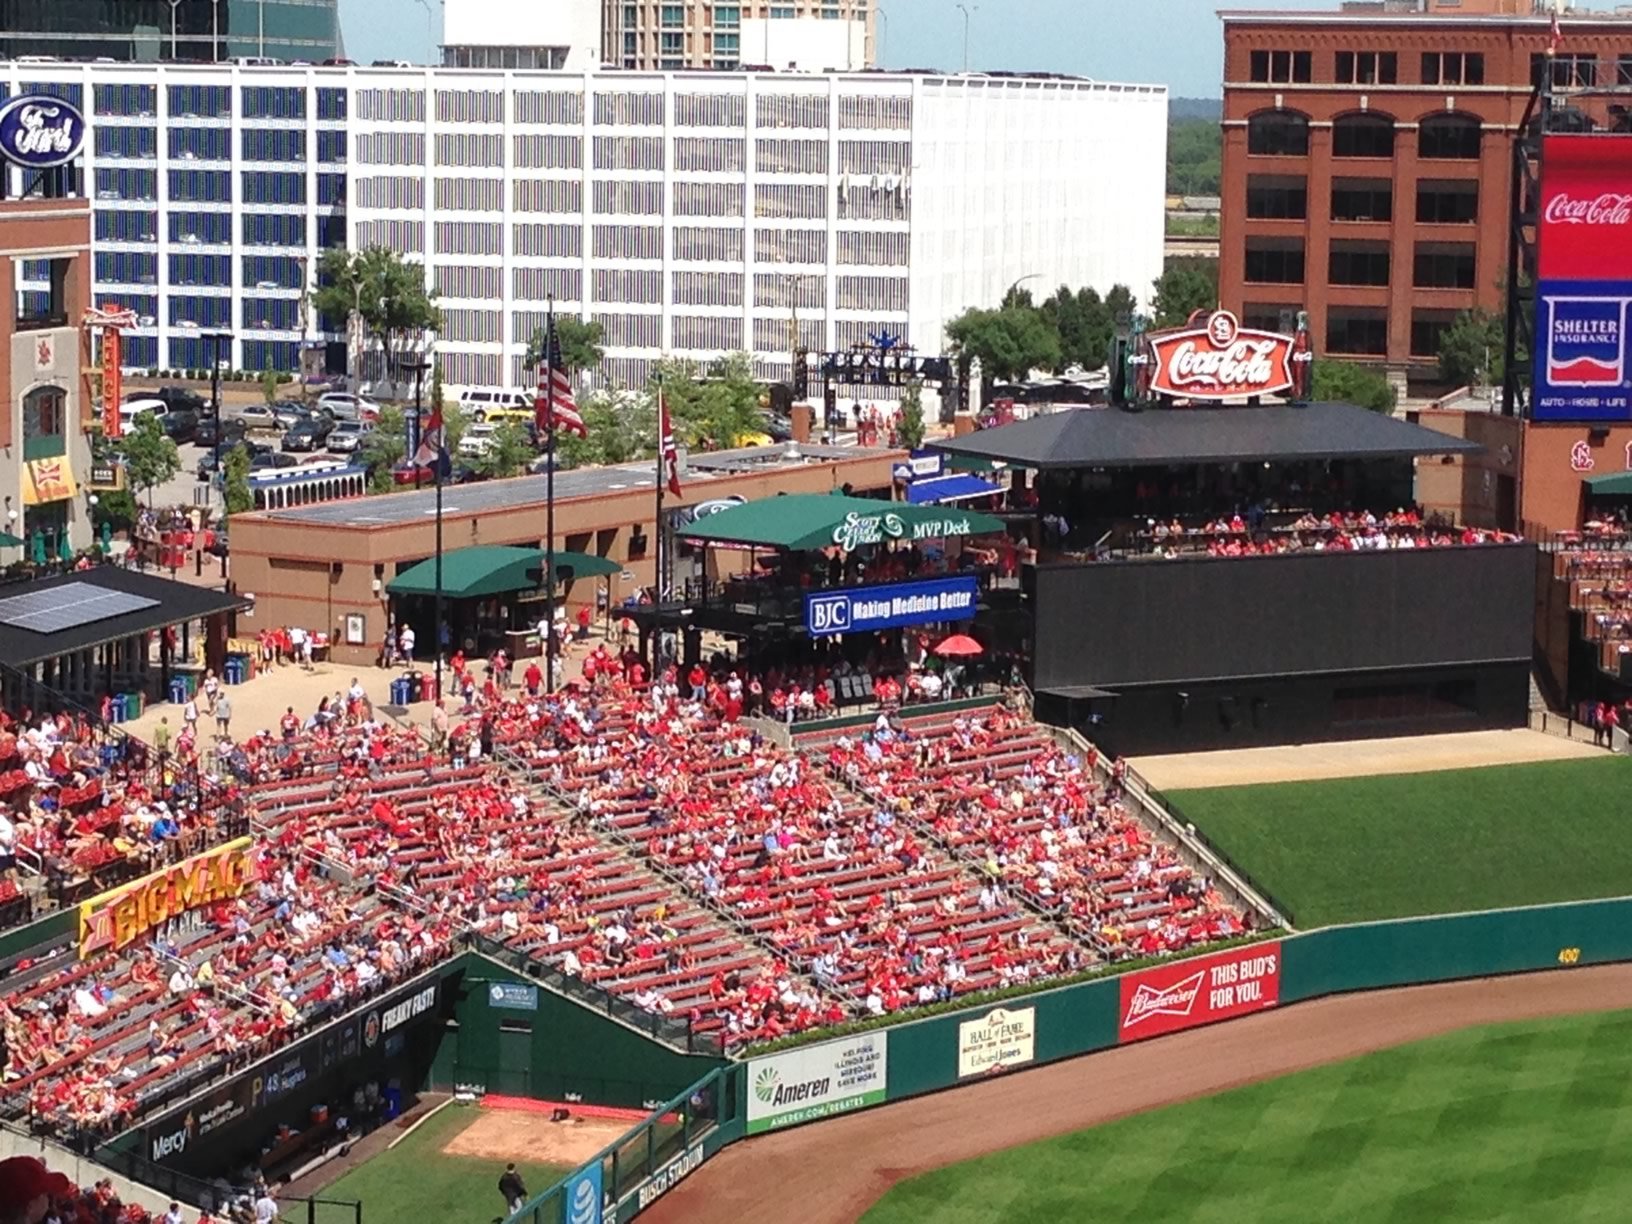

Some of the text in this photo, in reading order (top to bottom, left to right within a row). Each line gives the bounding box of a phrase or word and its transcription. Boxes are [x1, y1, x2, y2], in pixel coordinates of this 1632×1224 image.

[15, 105, 73, 154] Ford
[1554, 319, 1618, 334] SHELTER
[1554, 334, 1618, 344] INSURANCE
[1540, 397, 1566, 407] AUTO
[1606, 397, 1627, 407] LIFE
[913, 519, 971, 539] MVP Deck
[814, 602, 846, 630] BJC
[853, 591, 972, 621] Making Medicine Better
[115, 852, 245, 950] BIG MAC
[1210, 955, 1277, 987] THIS BUD'S
[1131, 989, 1197, 1015] Budweiser
[1209, 988, 1235, 1010] FOR
[381, 998, 412, 1033] FREAKY
[970, 1028, 993, 1044] HALL
[1001, 1022, 1024, 1037] FAME
[772, 1077, 831, 1107] Ameren
[152, 1127, 187, 1161] Mercy
[639, 1144, 703, 1209] BUSCH STADIUM
